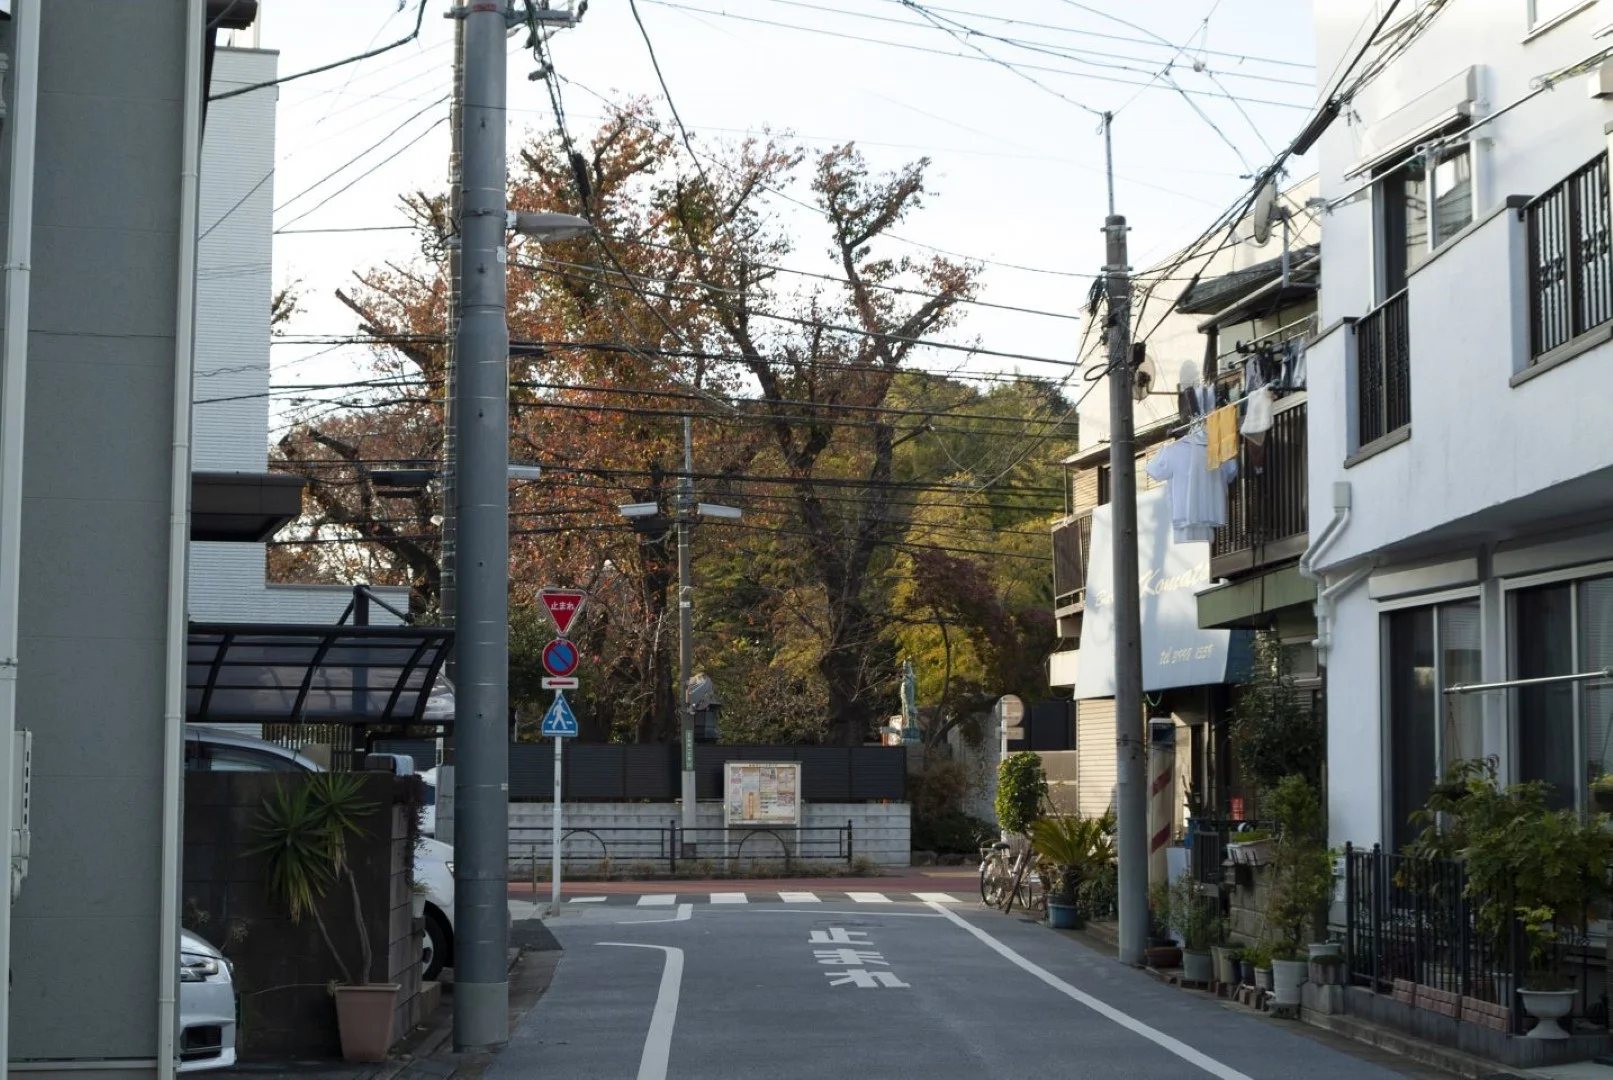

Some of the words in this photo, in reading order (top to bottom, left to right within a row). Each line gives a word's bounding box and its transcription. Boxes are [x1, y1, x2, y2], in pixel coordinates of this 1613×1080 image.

[550, 601, 575, 611] 止まれ
[808, 927, 911, 988] 止まれ
